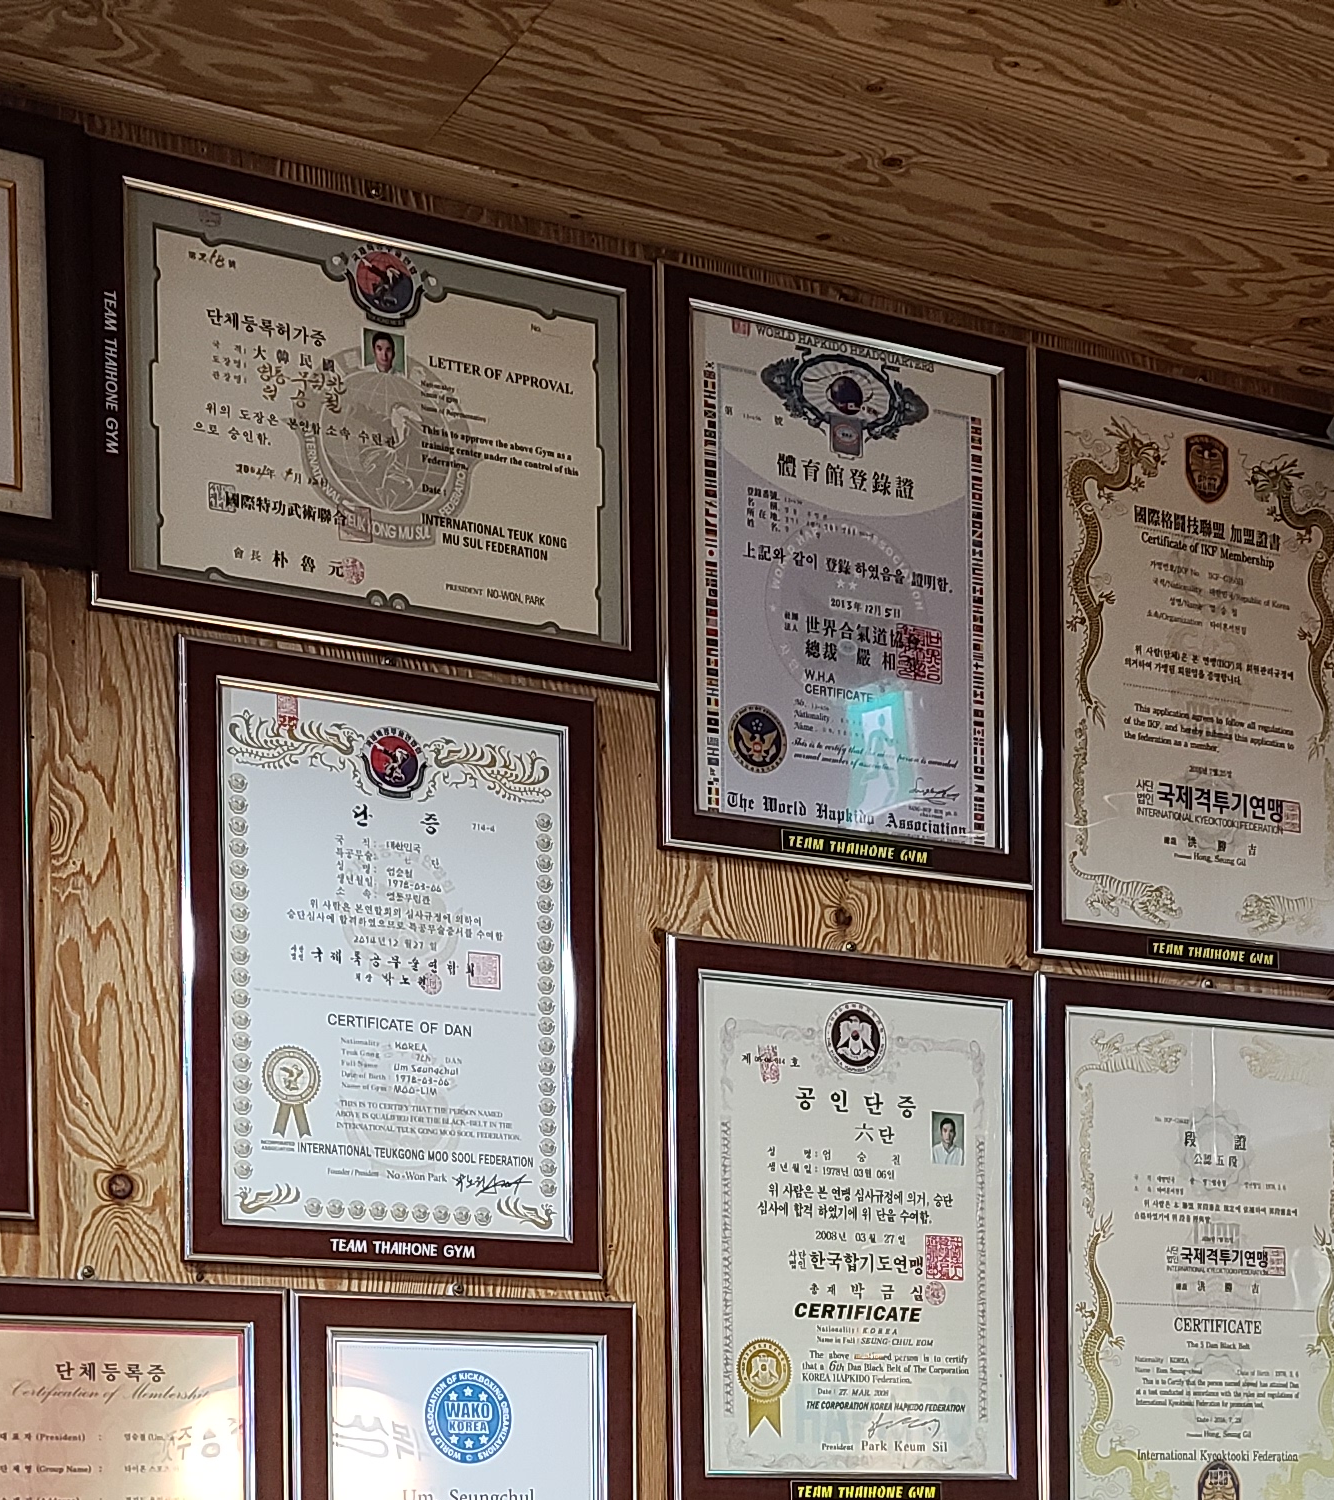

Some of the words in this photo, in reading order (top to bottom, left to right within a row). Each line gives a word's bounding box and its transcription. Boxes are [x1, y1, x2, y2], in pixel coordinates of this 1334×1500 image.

[104, 289, 118, 329] TEAM
[206, 307, 327, 348] 단체등록허가증
[104, 333, 118, 416] THAIHONE
[428, 355, 482, 376] LETTER
[505, 369, 573, 395] APPROVAL
[104, 420, 119, 454] GYM
[421, 513, 504, 540] INTERNATIONAL
[507, 524, 534, 543] TEUK
[538, 528, 567, 548] KONG
[442, 532, 458, 547] MU
[462, 535, 482, 550] SUL
[486, 538, 548, 561] FEDERATION
[1141, 532, 1186, 550] Certificate
[1190, 541, 1201, 552] of
[1204, 542, 1217, 554] IKF
[1220, 546, 1275, 571] Membership
[1156, 781, 1284, 823] 국제격투기연맹
[789, 834, 825, 853] TEAM
[830, 838, 895, 860] THAIHONE
[899, 845, 927, 864] GYM
[1153, 942, 1184, 956] TEAM
[1188, 947, 1246, 964] THAIHONE
[1249, 951, 1274, 966] GYM
[327, 1011, 413, 1034] CERTIFICATE
[420, 1019, 438, 1035] OF
[443, 1021, 473, 1039] DAN
[796, 1086, 917, 1120] 공인단증
[297, 1142, 371, 1158] INTERNATIONAL
[373, 1146, 424, 1161] TEUKGONG
[427, 1150, 447, 1163] MOO
[450, 1151, 475, 1165] SOOL
[478, 1153, 534, 1169] FEDERATION
[330, 1237, 367, 1255] TEAM
[373, 1240, 438, 1258] THAIHONE
[443, 1244, 475, 1260] GYM
[1180, 1247, 1268, 1269] 국제격투기연맹
[810, 1249, 924, 1277] 한국합기도연맹
[794, 1303, 922, 1323] CERTIFICATE
[1174, 1317, 1262, 1335] CERTIFICATE
[55, 1361, 167, 1383] 단체등록증
[444, 1402, 491, 1418] WAKO
[449, 1420, 488, 1432] KOREA
[861, 1439, 890, 1452] Park
[894, 1441, 927, 1453] Keum
[933, 1441, 948, 1452] Sil
[1137, 1449, 1196, 1463] International
[1253, 1451, 1299, 1462] Federation
[798, 1484, 834, 1499] TEAM
[838, 1484, 905, 1500] THAIHONE
[908, 1484, 936, 1500] GYM
